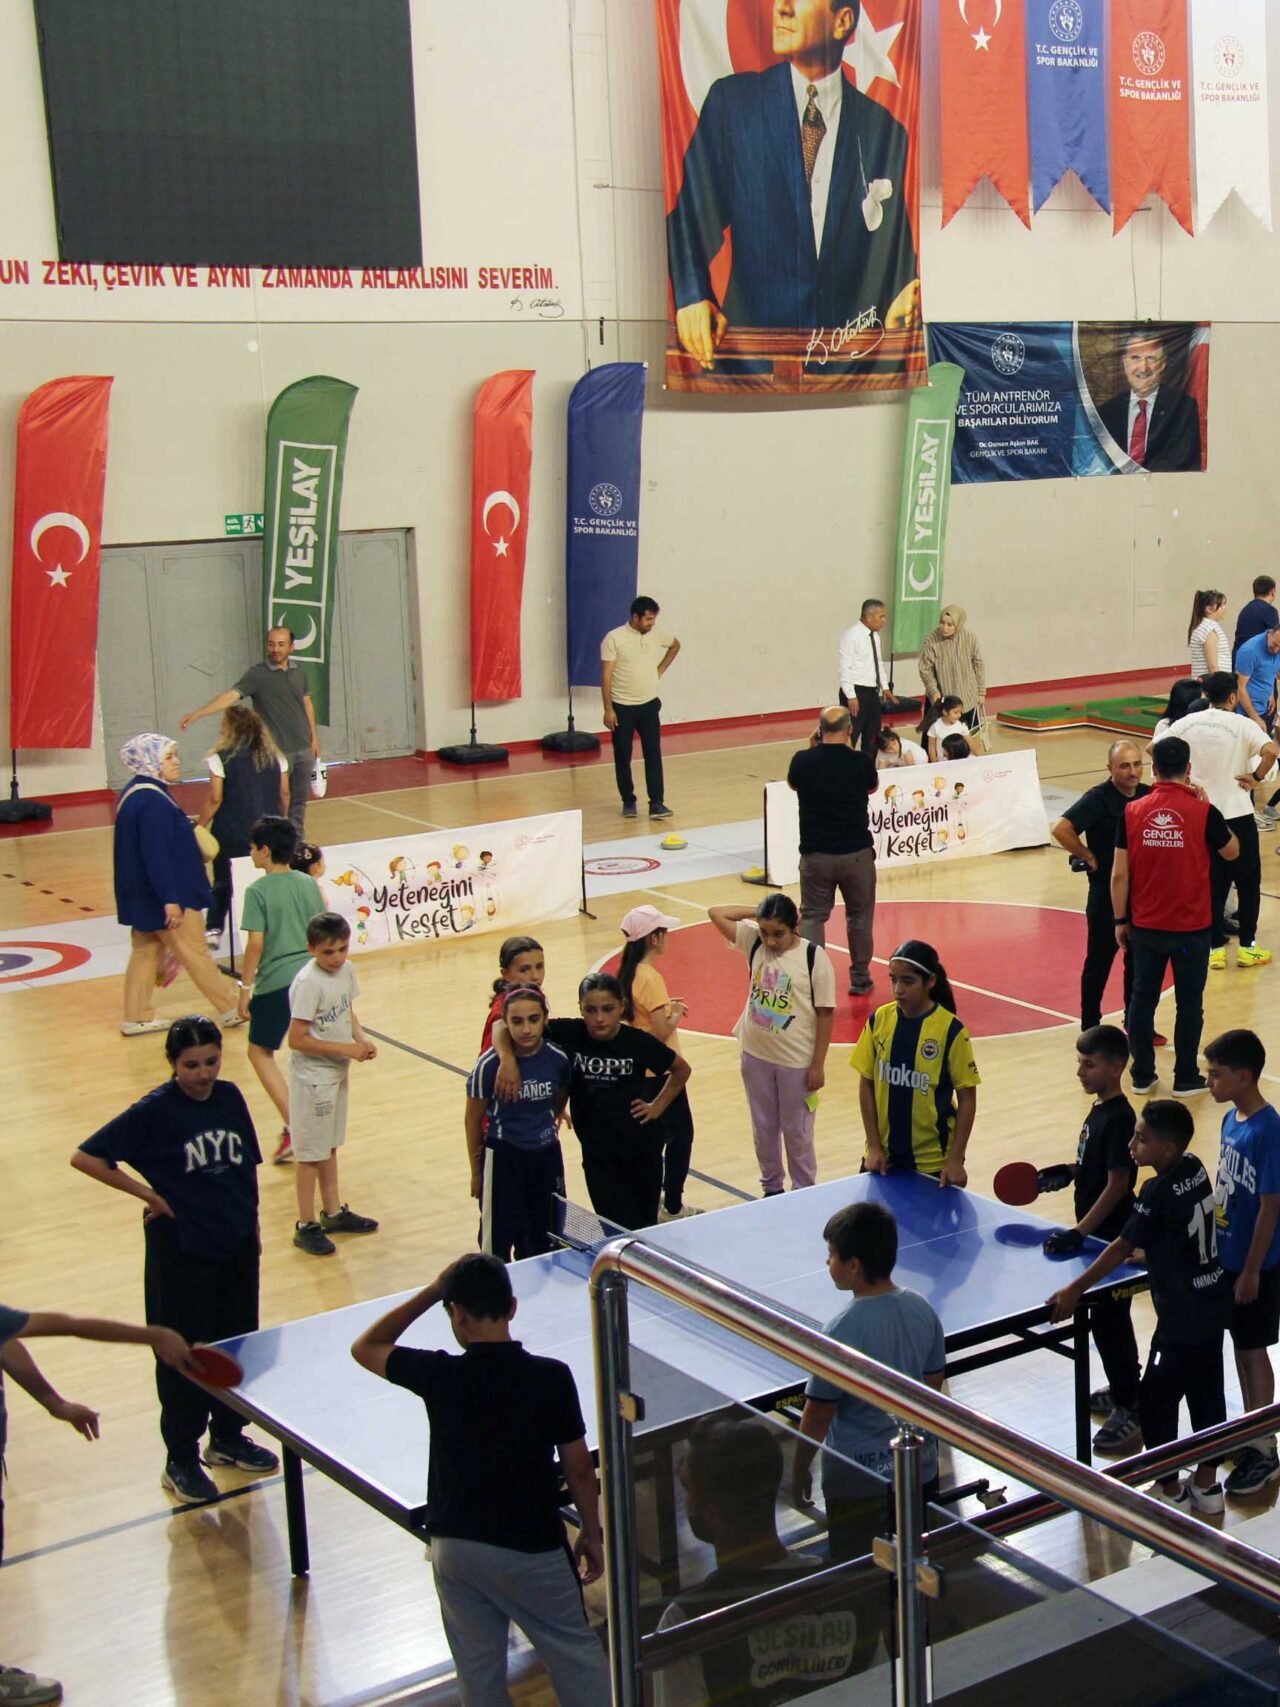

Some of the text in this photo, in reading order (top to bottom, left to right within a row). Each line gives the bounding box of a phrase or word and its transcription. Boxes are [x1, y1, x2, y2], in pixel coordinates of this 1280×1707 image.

[1050, 45, 1087, 57] GENÇLİK
[1089, 47, 1098, 56] VE
[1036, 56, 1098, 68] SPOR BAKANLIĞI
[1119, 76, 1182, 91] T.C. GENÇLİK VE
[1215, 82, 1247, 93] GENÇLİK
[1119, 88, 1182, 100] SPOR BAKANLIĞI
[1200, 93, 1220, 102] SPOR
[172, 264, 198, 287] VE
[207, 265, 251, 288] AYNI
[262, 265, 353, 289] ZAMANDA
[966, 389, 1050, 403] TÜM ANTRENÖR
[969, 402, 1062, 415] SPORCULARIMIZA
[958, 415, 1059, 429] BAŞARILAR DİLİYORUM
[998, 449, 1006, 457] VE
[914, 431, 940, 542] YEŞİLAY
[284, 457, 322, 590] YEŞİLAY
[573, 517, 637, 528] T.C. GENÇLİK VE
[573, 526, 637, 537] SPOR BAKANLIĞI
[872, 804, 949, 834] Yeteneğini
[1143, 829, 1184, 840] GENÇLİK
[887, 829, 945, 858] Keşfet
[373, 876, 474, 913] Yeteneğini
[396, 904, 470, 940] Keşfet
[574, 1052, 633, 1075] NOPE
[519, 1081, 552, 1099] ANCE
[184, 1130, 243, 1174] NYC
